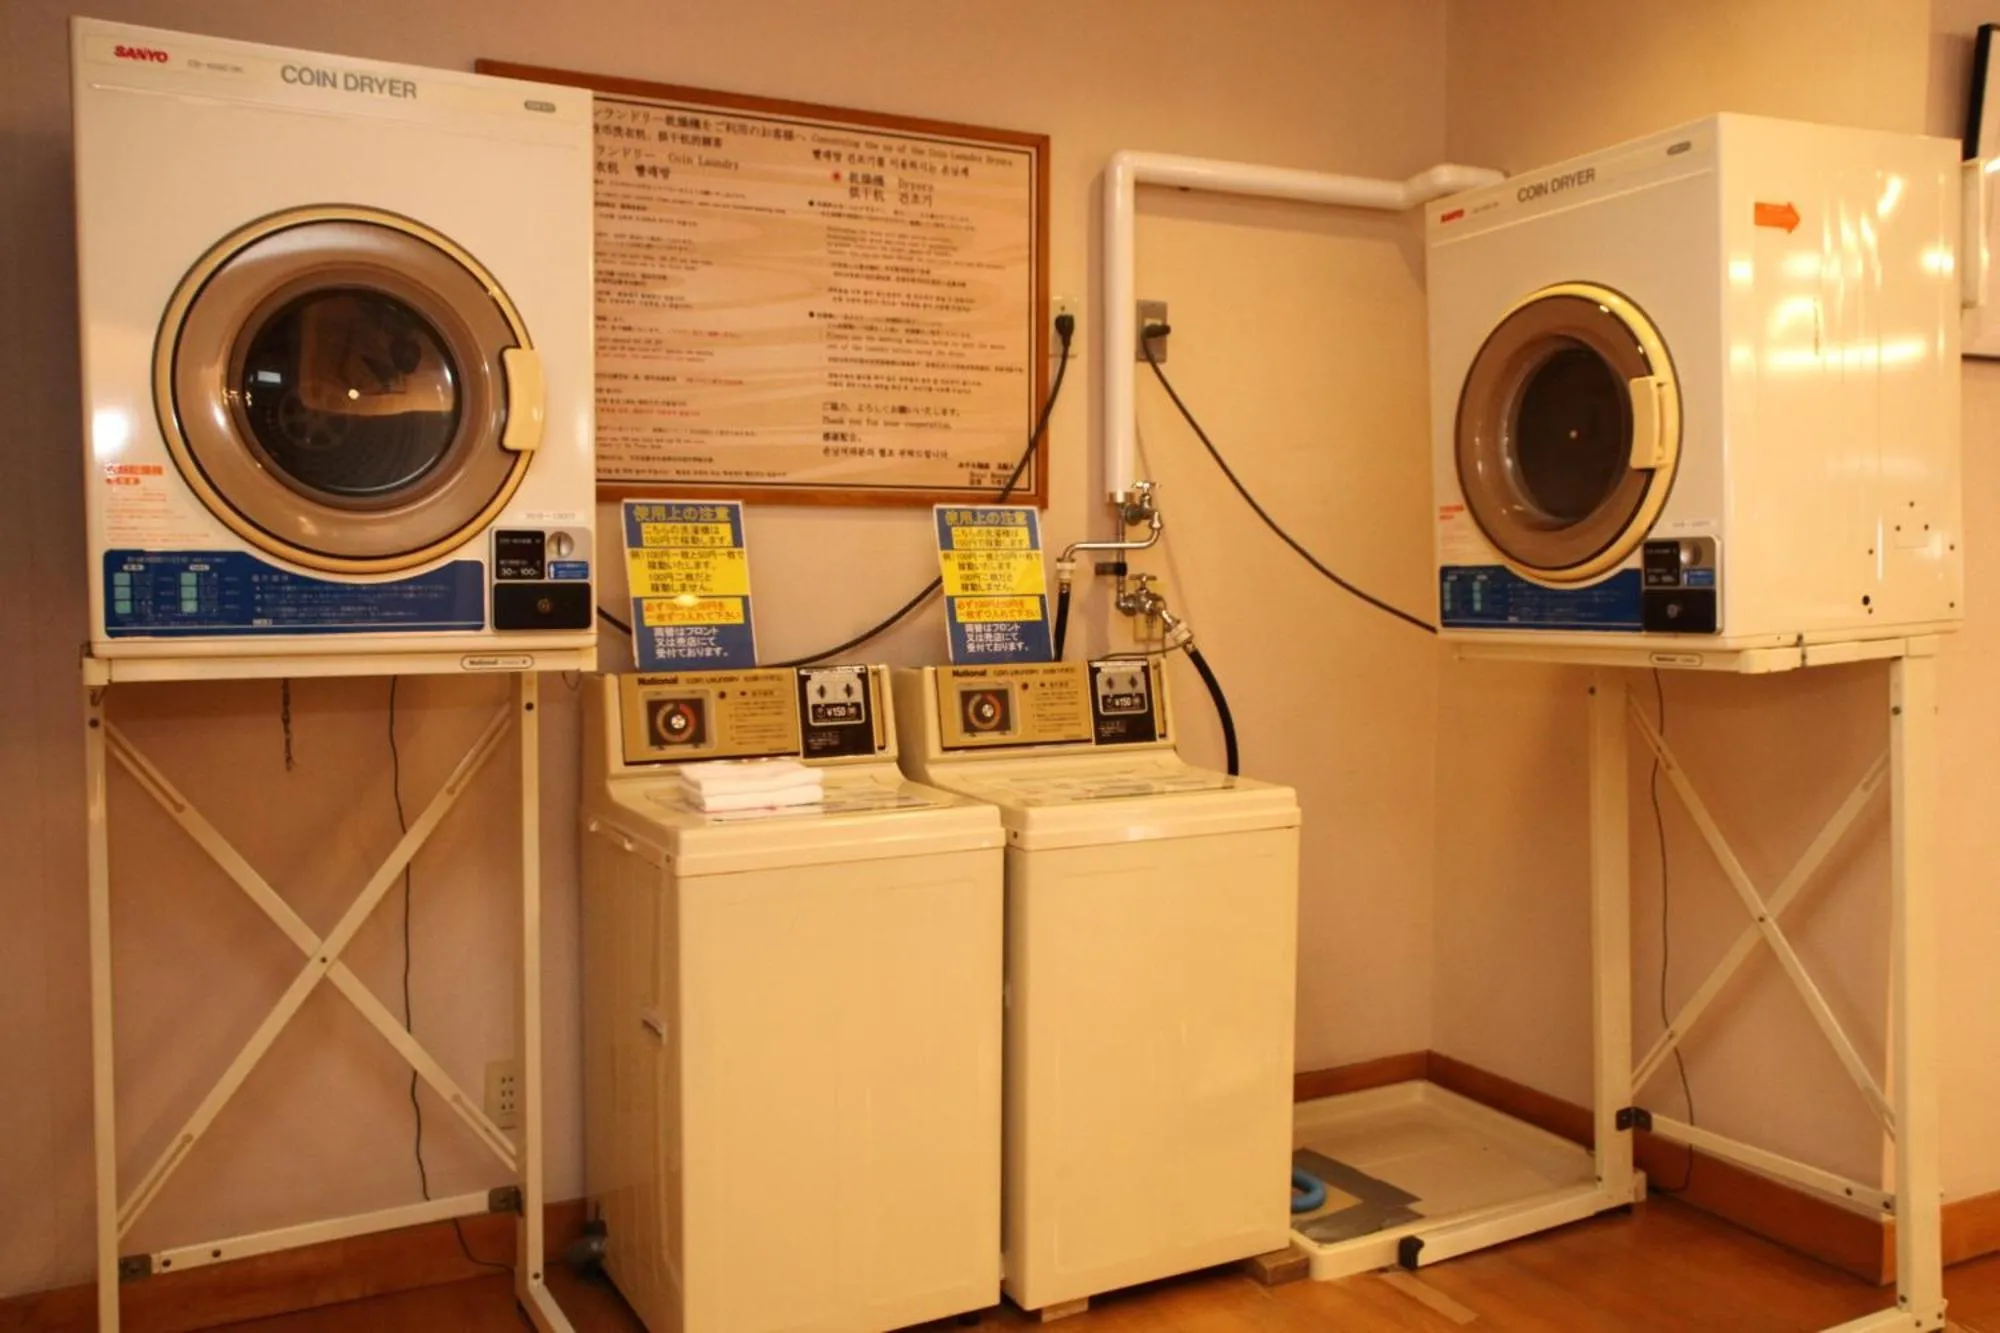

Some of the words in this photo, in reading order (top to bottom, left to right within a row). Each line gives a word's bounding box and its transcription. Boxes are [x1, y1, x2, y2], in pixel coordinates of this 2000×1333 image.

[113, 45, 169, 63] SANYO
[280, 64, 338, 89] COIN
[343, 73, 417, 99] DRYER
[667, 152, 694, 166] Coin
[698, 155, 739, 171] Laundry
[1516, 180, 1549, 204] COIN
[1550, 166, 1597, 194] DRYER
[634, 504, 731, 522] 使用上の注意
[945, 510, 1028, 526] 使用上の注意
[637, 675, 678, 686] National
[952, 668, 987, 677] National
